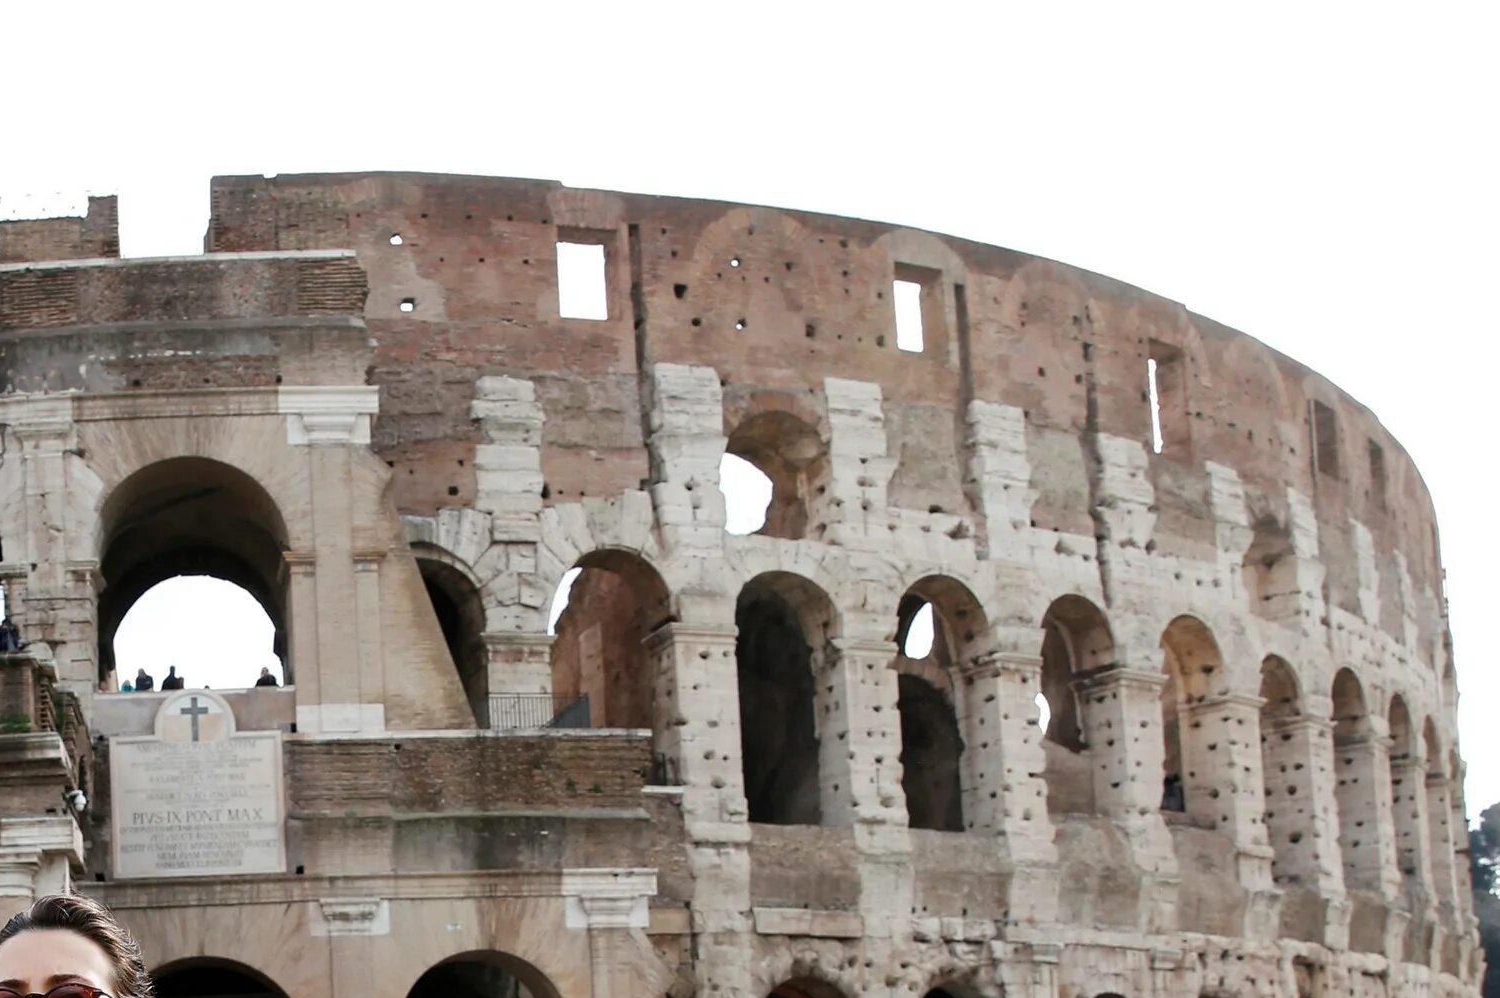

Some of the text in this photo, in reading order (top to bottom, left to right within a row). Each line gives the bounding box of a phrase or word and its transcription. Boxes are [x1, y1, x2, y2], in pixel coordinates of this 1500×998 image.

[133, 807, 264, 825] PIVS IX PONT MAX
